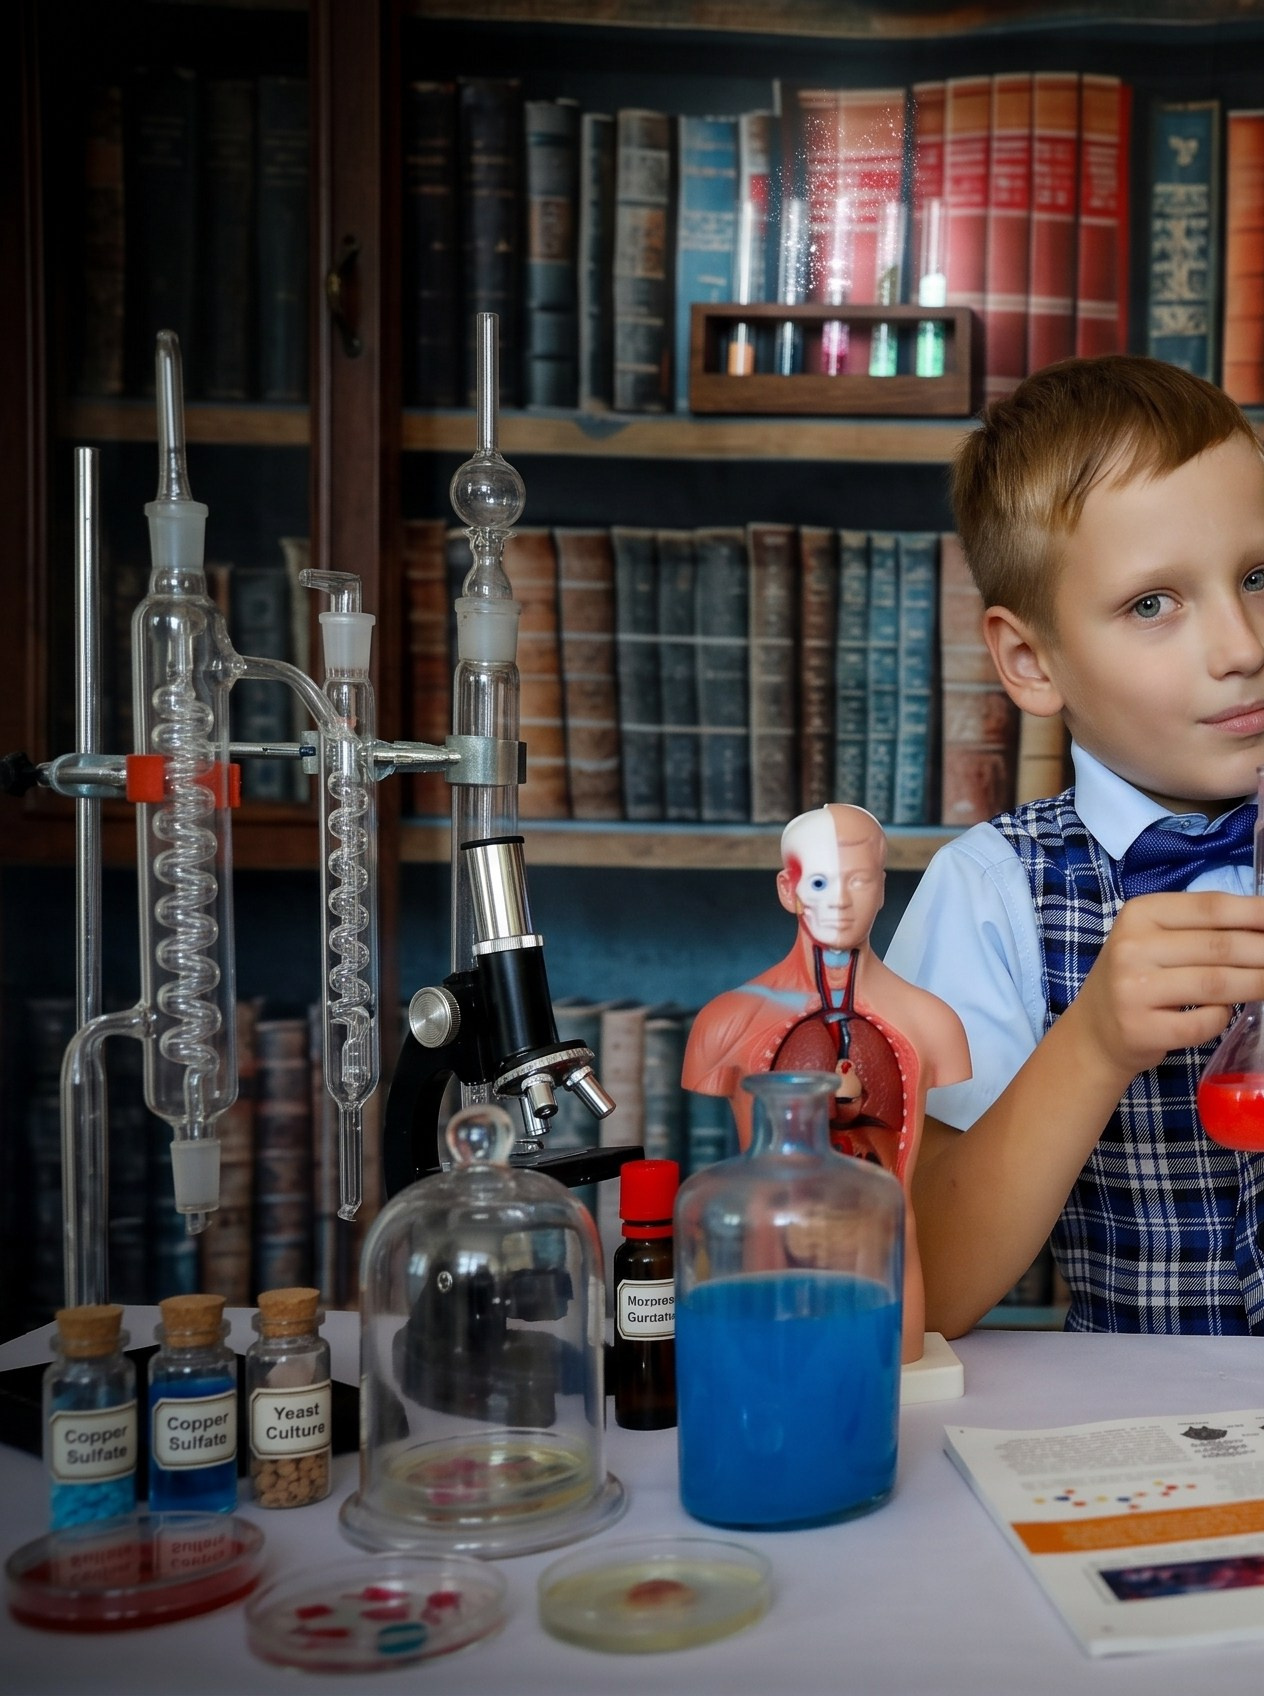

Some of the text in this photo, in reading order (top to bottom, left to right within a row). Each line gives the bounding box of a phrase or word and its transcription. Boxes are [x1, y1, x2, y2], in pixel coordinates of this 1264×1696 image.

[274, 1403, 319, 1420] Yeast
[167, 1412, 228, 1433] Copper
[266, 1423, 325, 1440] Culture
[65, 1425, 127, 1446] Copper
[169, 1433, 226, 1452] Sulfate
[67, 1446, 127, 1465] Sulfate
